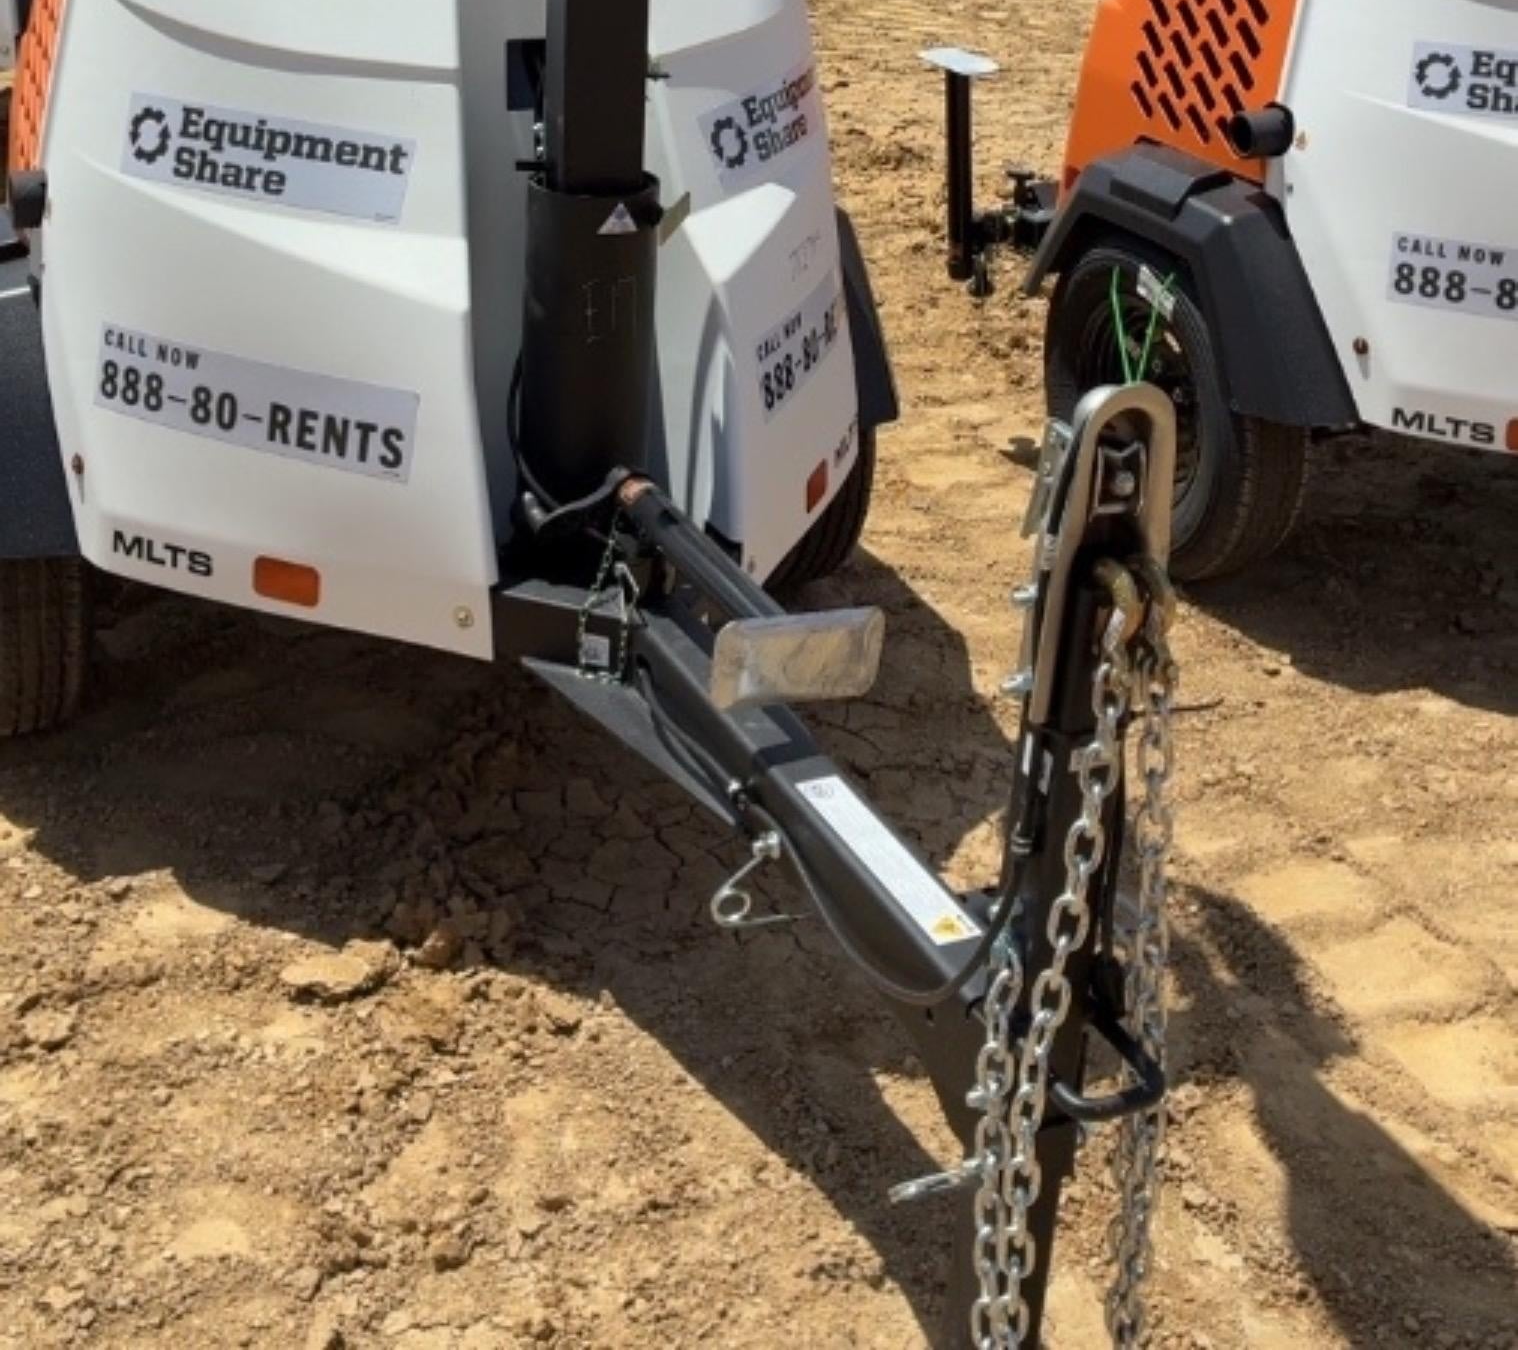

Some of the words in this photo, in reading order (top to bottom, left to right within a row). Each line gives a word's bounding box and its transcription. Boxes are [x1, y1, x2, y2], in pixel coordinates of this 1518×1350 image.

[1470, 50, 1518, 87] Eq
[178, 106, 408, 174] Equipment
[172, 146, 286, 195] Share
[1397, 236, 1446, 258] CALL
[1458, 246, 1504, 266] NOW
[1394, 263, 1518, 310] 888-8
[105, 329, 147, 358] CALL
[156, 344, 201, 370] NOW
[101, 359, 405, 469] 888-80-RENTS
[1392, 407, 1495, 444] MLTS
[113, 529, 213, 576] MLTS
